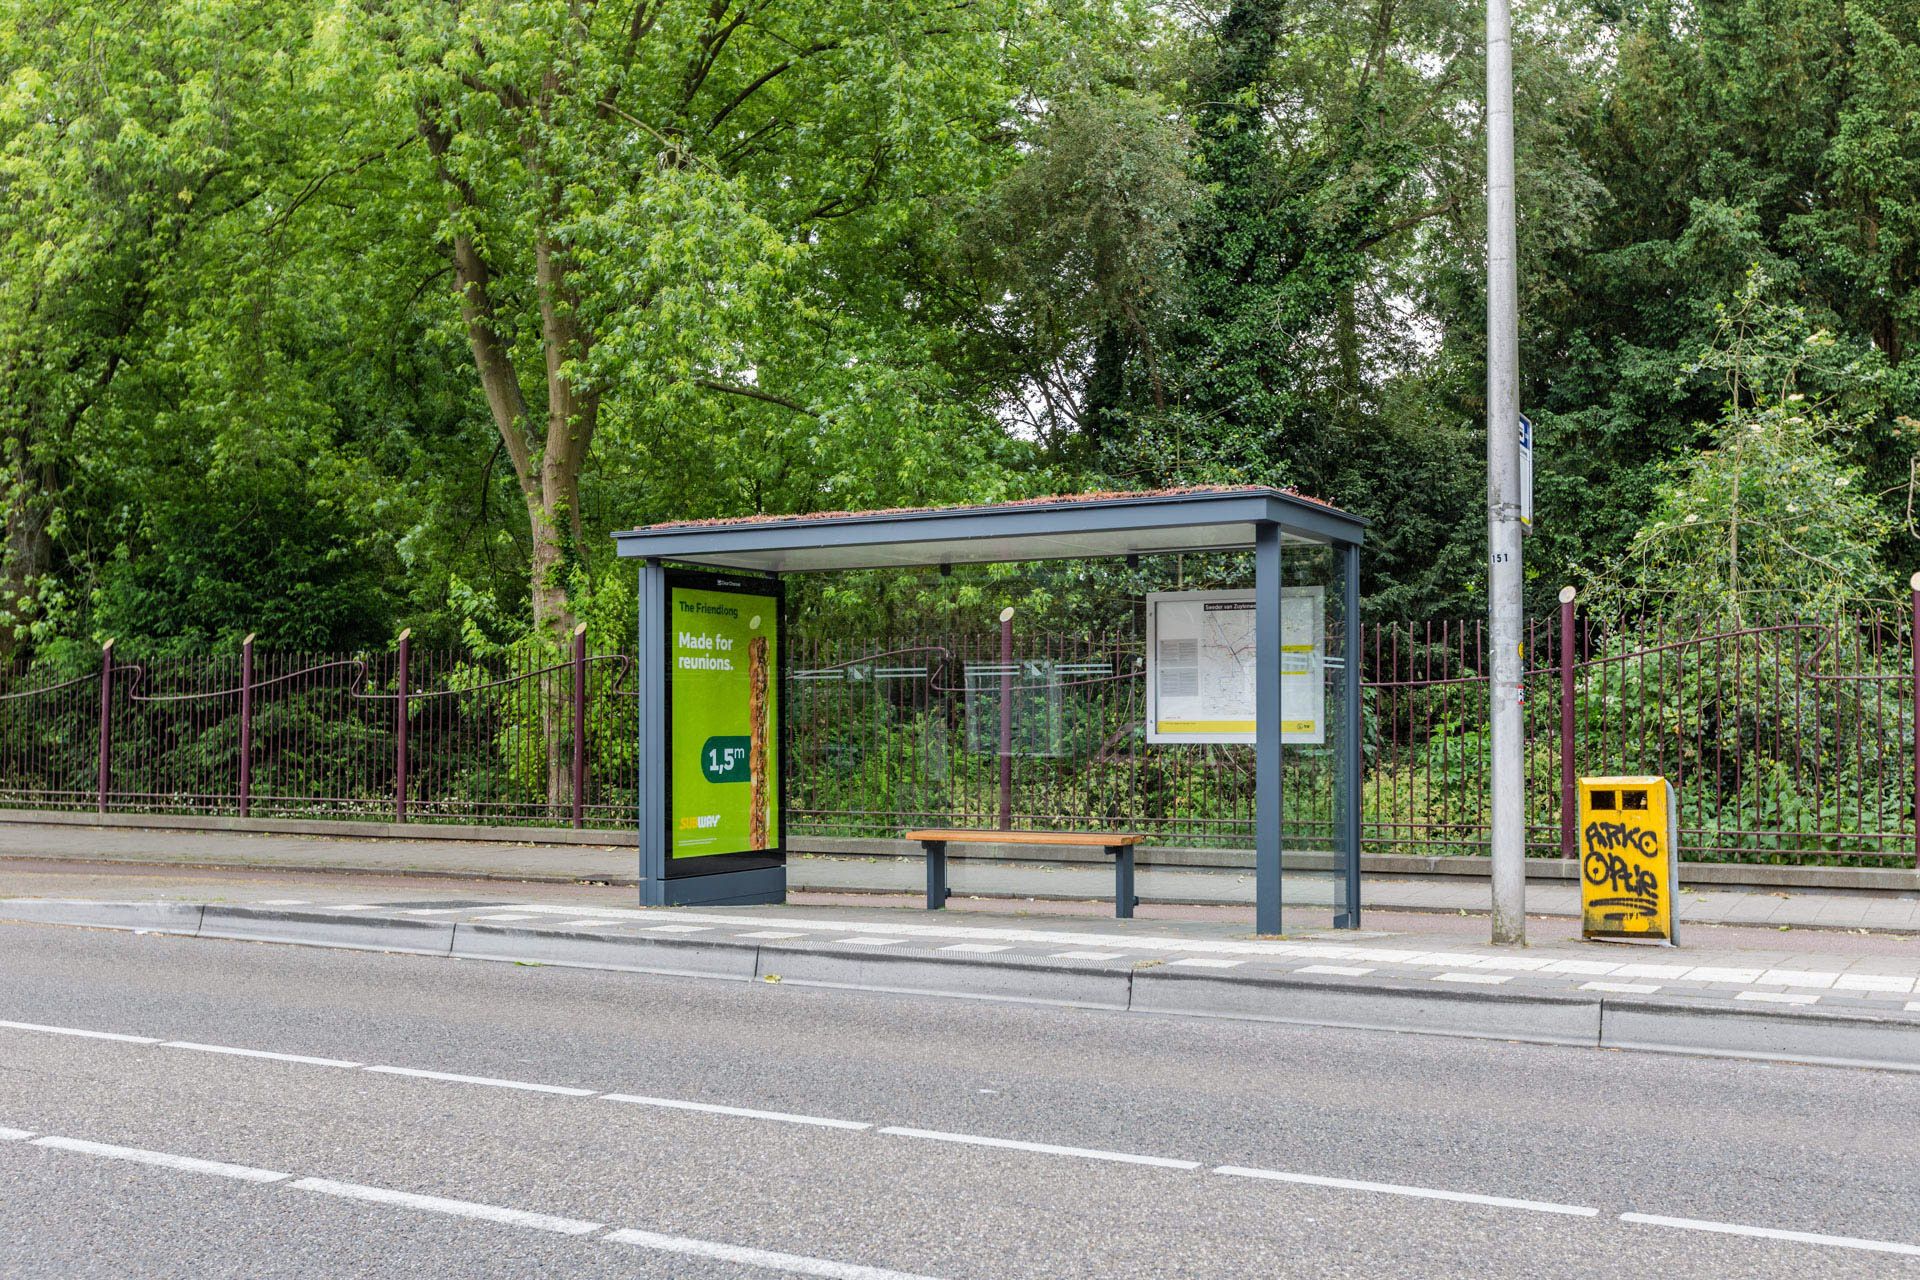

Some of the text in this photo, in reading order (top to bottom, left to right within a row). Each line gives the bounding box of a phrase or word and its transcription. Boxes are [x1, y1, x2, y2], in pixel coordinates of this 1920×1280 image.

[1492, 553, 1508, 563] 151
[679, 601, 739, 619] The Friendlong
[679, 631, 734, 651] Made for
[678, 653, 734, 671] reunions.
[679, 814, 721, 830] SUBWAY
